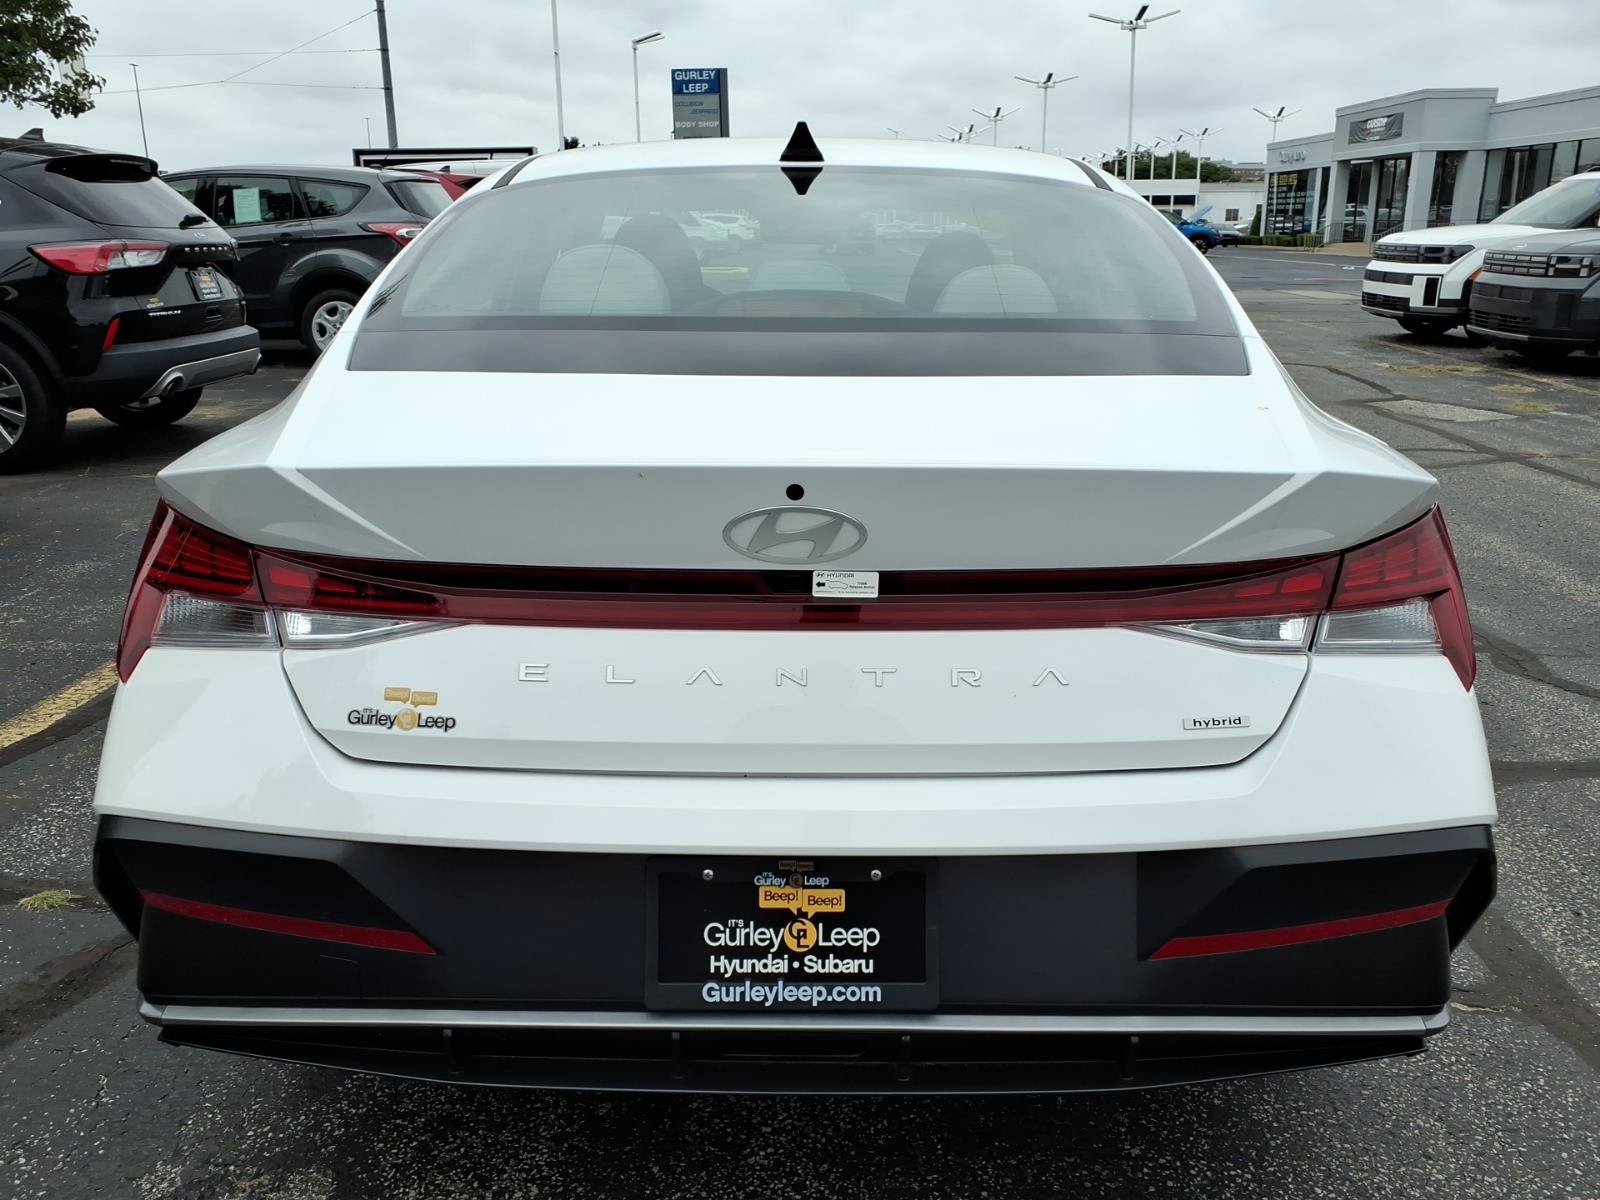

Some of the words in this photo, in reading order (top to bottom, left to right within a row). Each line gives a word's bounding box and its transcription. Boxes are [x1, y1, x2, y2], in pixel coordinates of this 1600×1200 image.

[674, 70, 716, 80] GURLEY
[682, 83, 709, 93] LEEP
[698, 120, 720, 128] SHOP
[518, 663, 1069, 687] ELANTRA
[347, 709, 398, 730] Gurley
[417, 712, 456, 732] Leep
[1193, 716, 1242, 728] hybrid
[754, 874, 786, 888] Gurley
[804, 876, 829, 887] Leep
[764, 890, 799, 903] Beep!
[807, 895, 842, 907] Beep!
[728, 919, 744, 927] IT'S
[703, 922, 785, 953] Gurley
[818, 923, 880, 953] Leep
[710, 955, 789, 978] Hyundai
[803, 954, 874, 973] Subaru
[702, 981, 882, 1007] Gurleyleep.com
